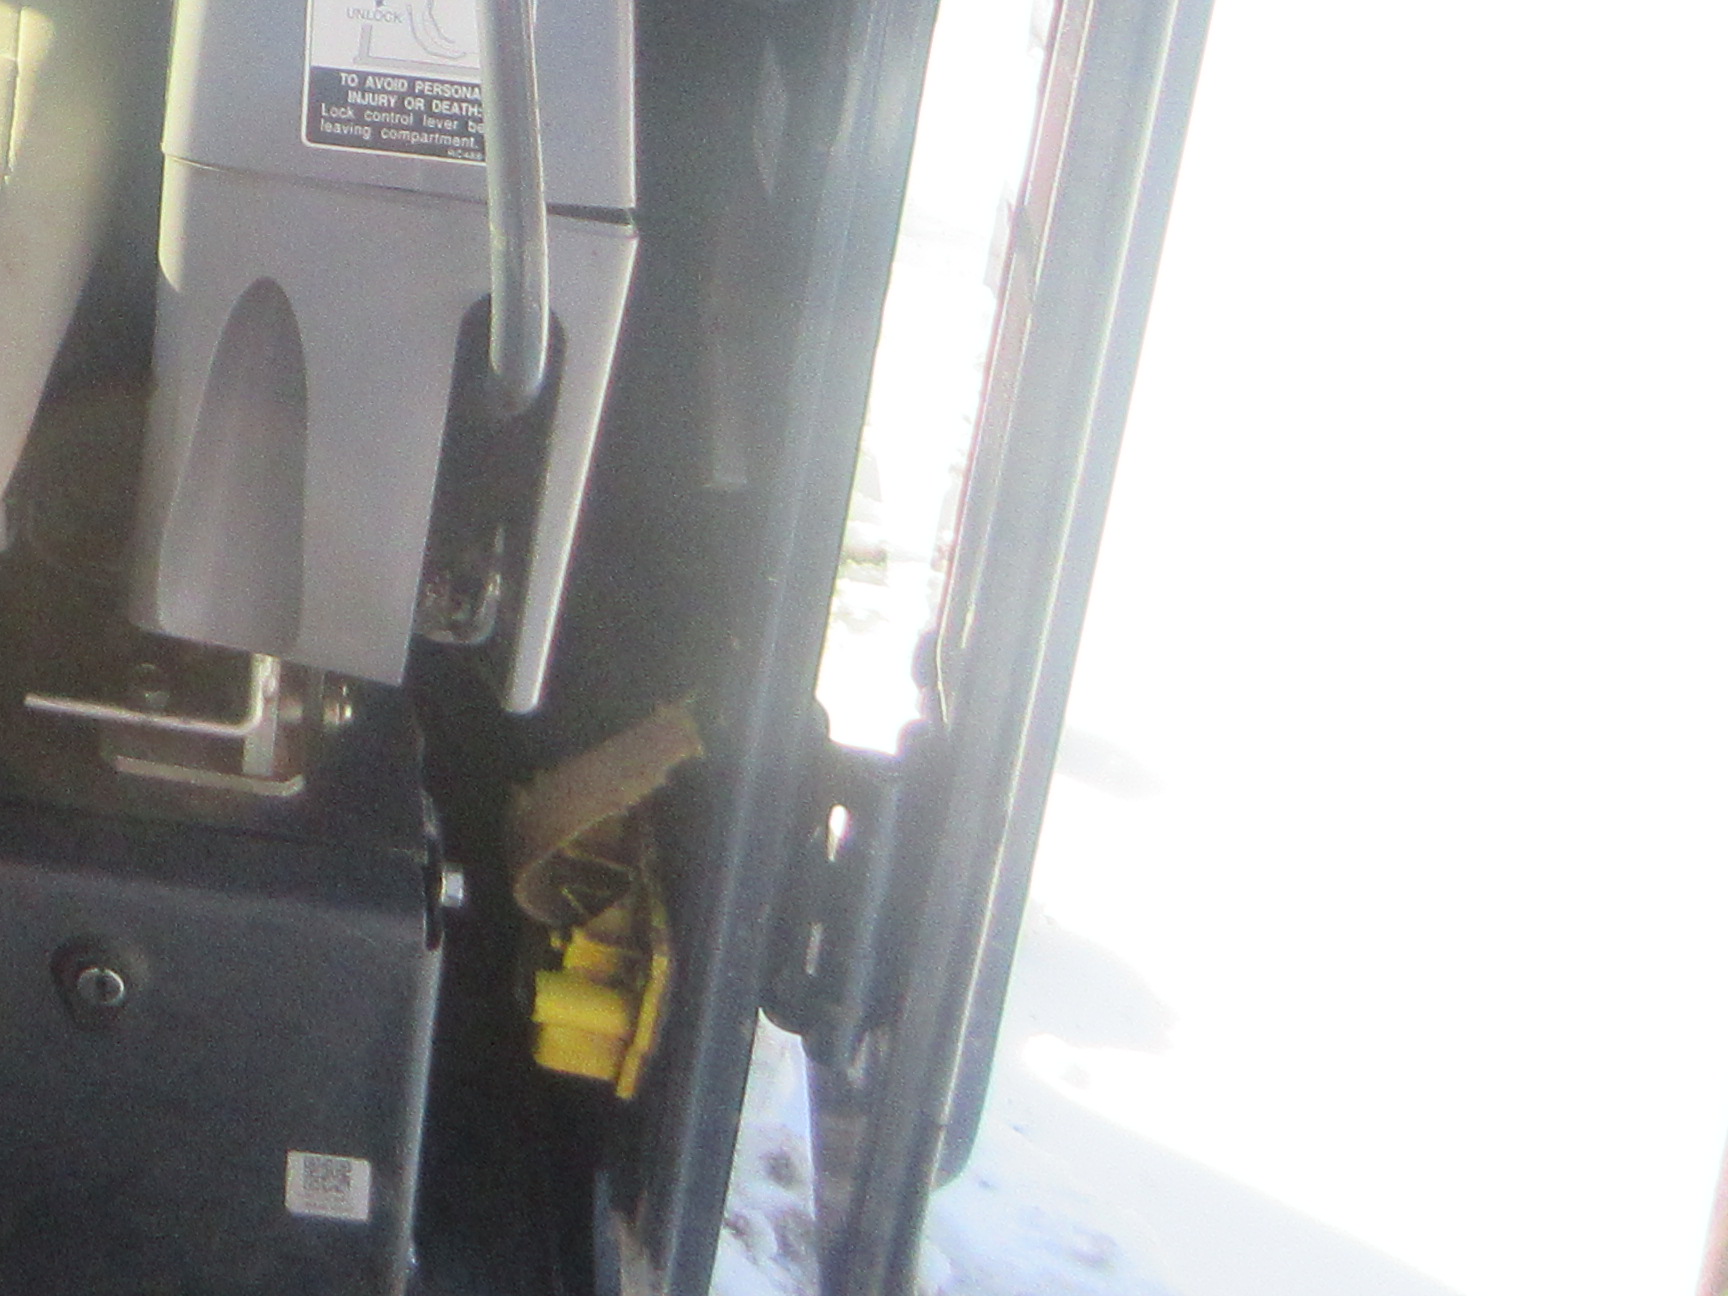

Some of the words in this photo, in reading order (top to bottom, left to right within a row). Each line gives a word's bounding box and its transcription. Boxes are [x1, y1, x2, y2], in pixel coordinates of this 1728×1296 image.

[346, 7, 404, 24] UNLOCK
[340, 73, 359, 88] TO
[365, 75, 408, 93] AVOID
[415, 79, 482, 101] PERSONA
[347, 90, 397, 108] INJURY
[404, 96, 426, 112] OR
[321, 102, 355, 121] Lock
[364, 107, 414, 126] control
[423, 114, 458, 131] lever
[320, 119, 372, 139] leaving
[381, 128, 479, 150] compartment.
